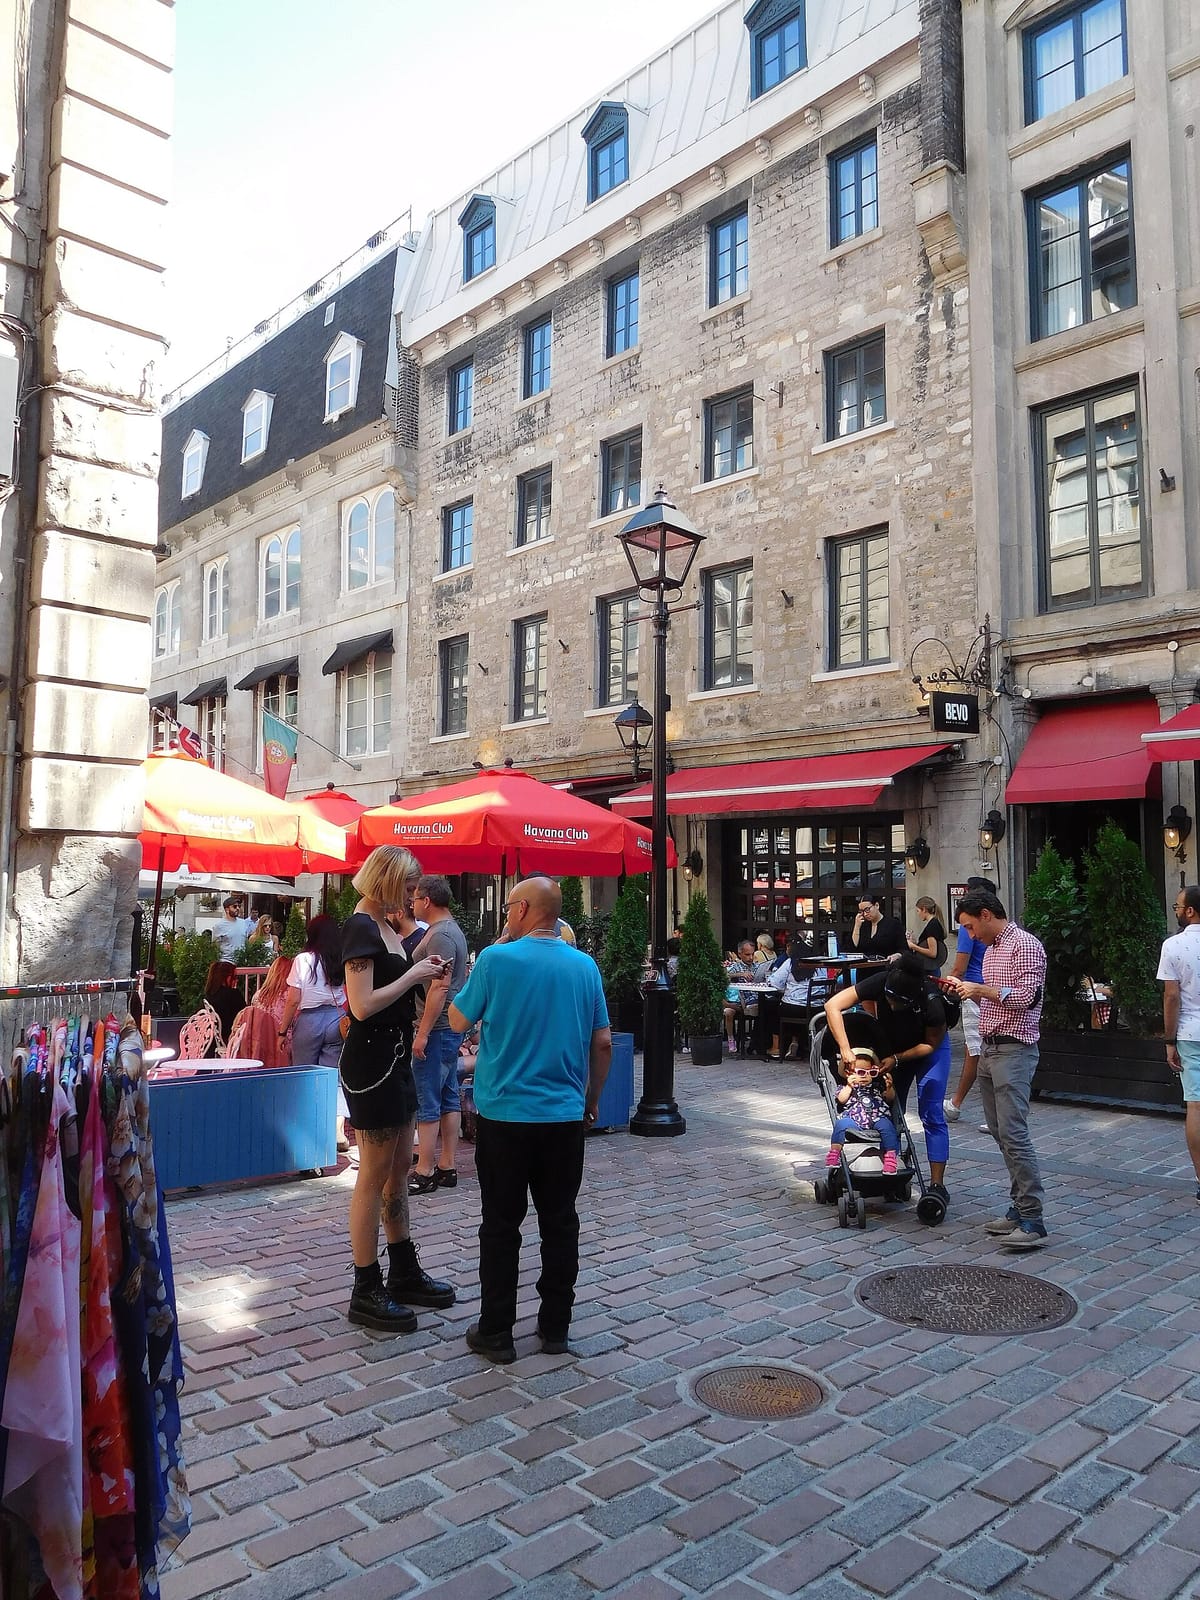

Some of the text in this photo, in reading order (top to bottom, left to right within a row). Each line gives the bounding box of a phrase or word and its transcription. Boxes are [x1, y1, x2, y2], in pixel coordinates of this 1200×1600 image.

[945, 702, 969, 721] BEVO
[394, 822, 454, 835] Havana Club
[524, 823, 589, 841] Havana Club
[950, 887, 965, 895] BEVO
